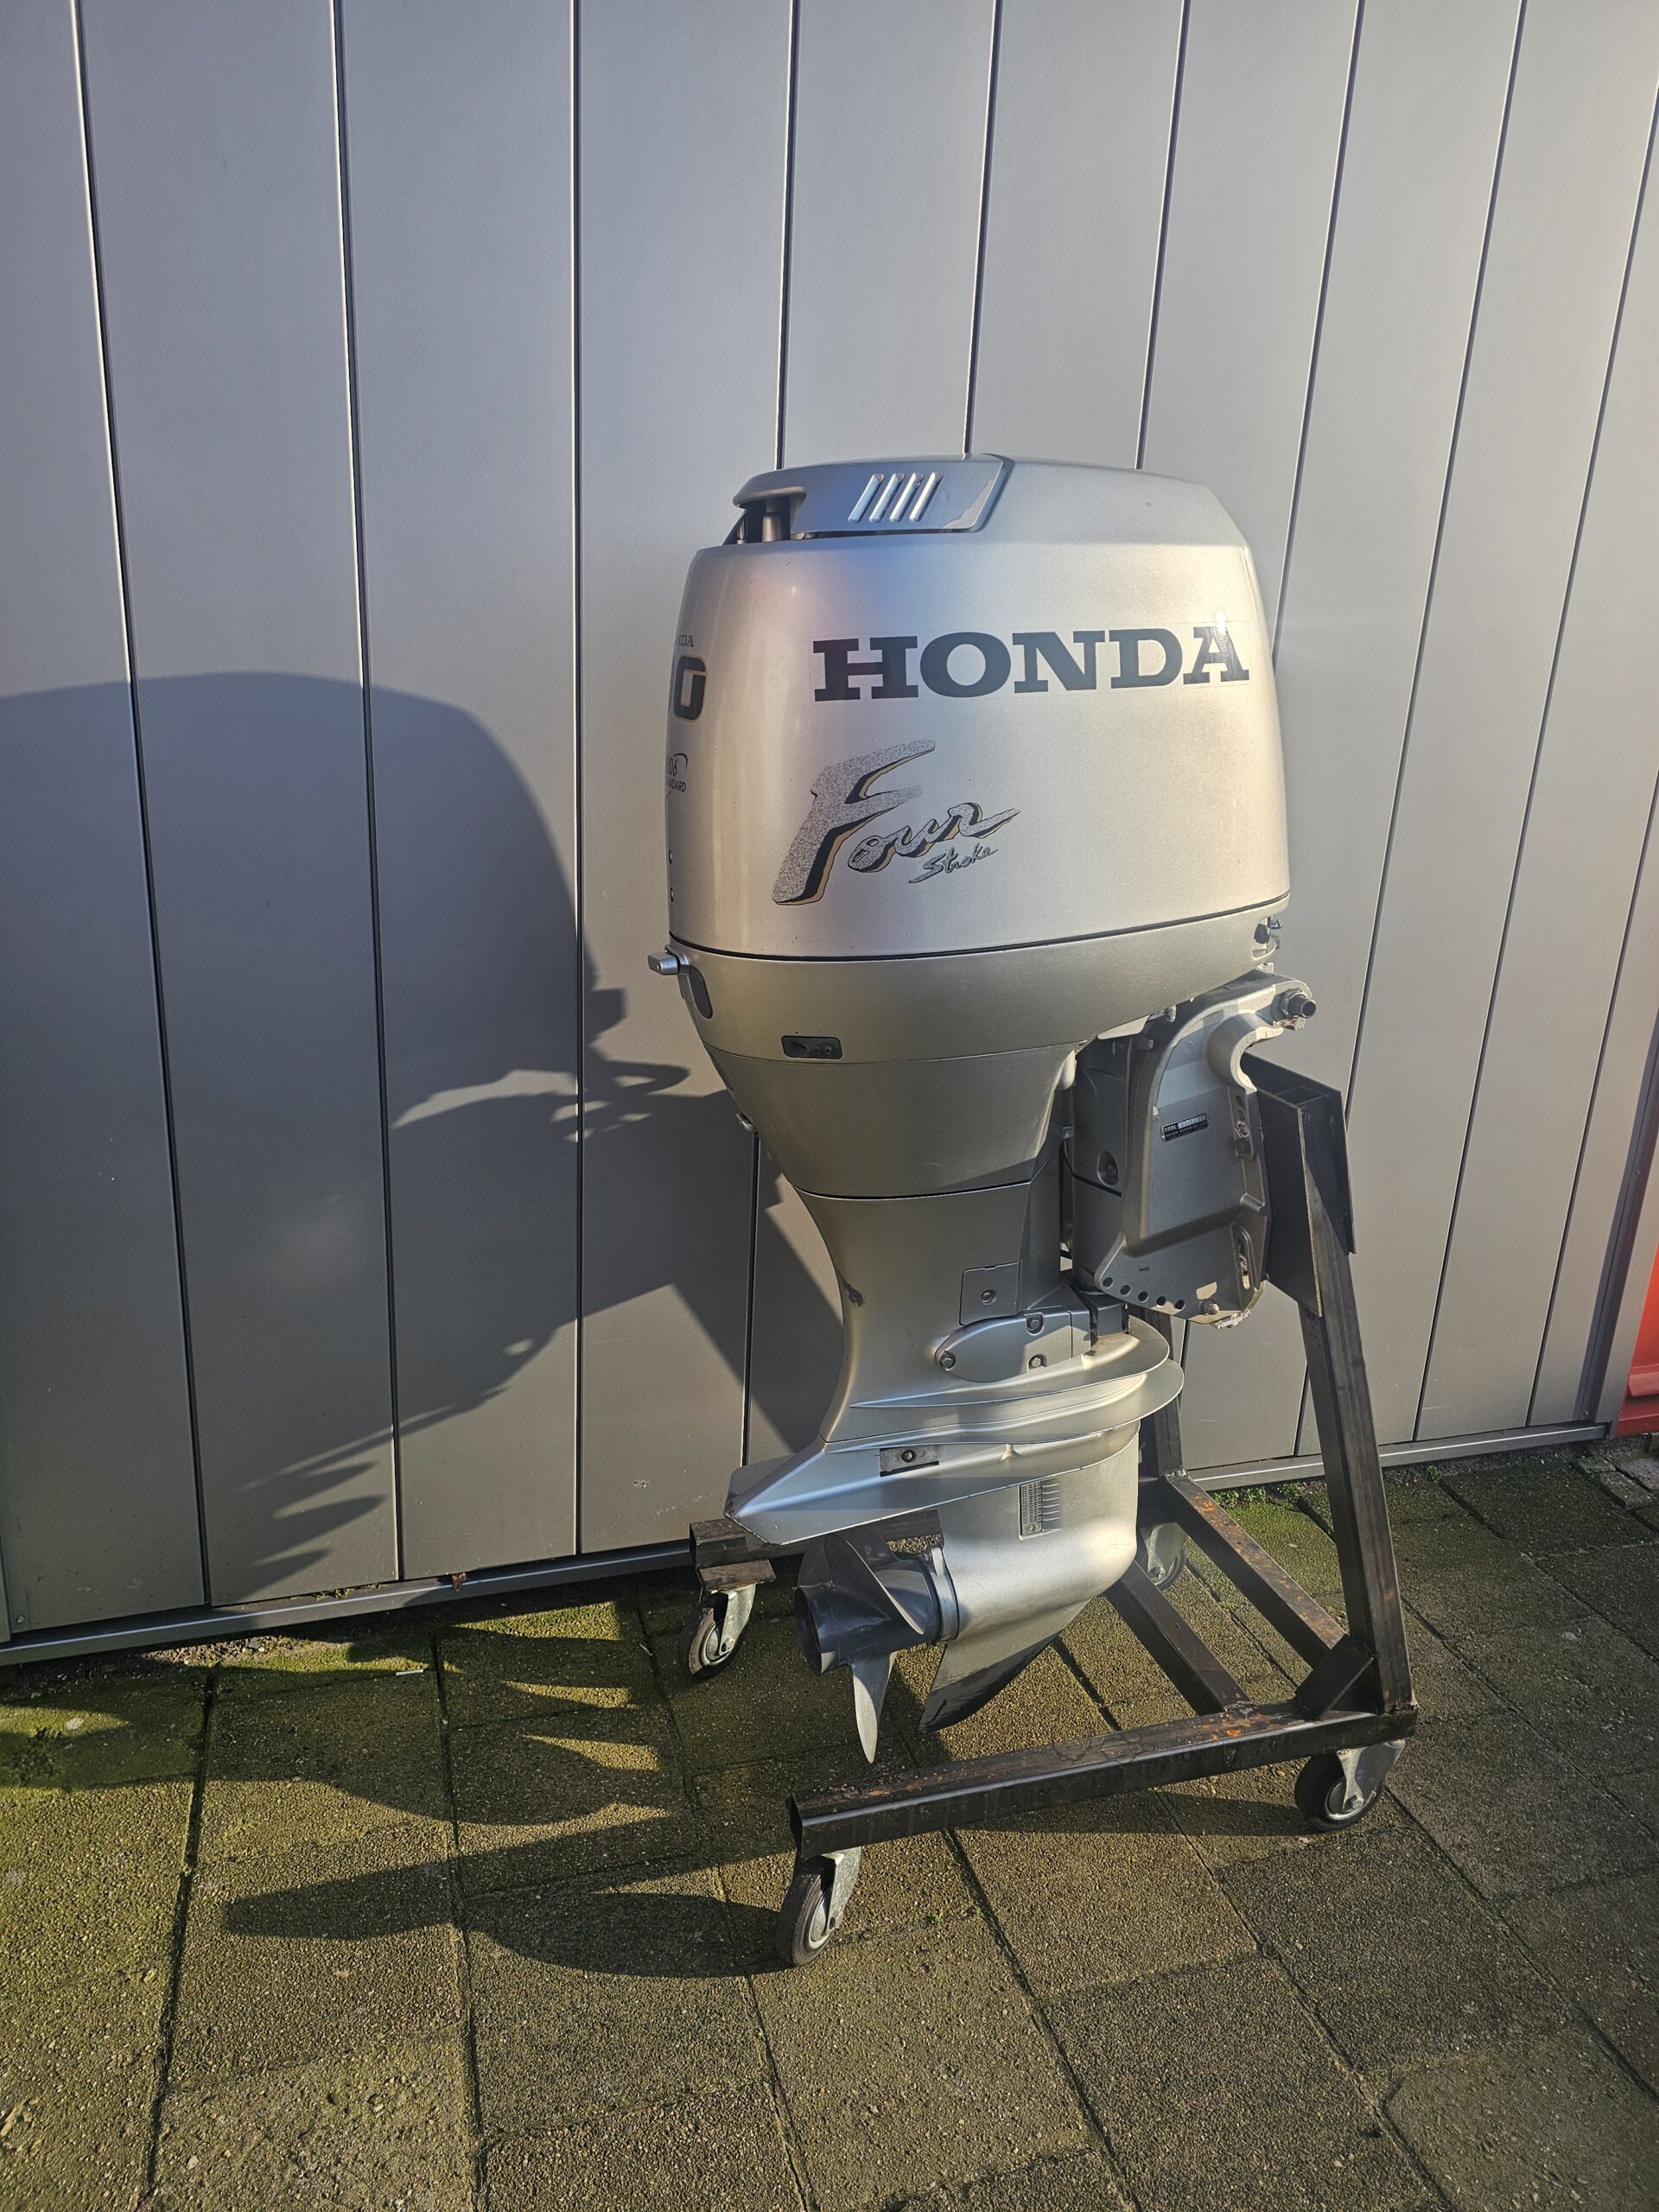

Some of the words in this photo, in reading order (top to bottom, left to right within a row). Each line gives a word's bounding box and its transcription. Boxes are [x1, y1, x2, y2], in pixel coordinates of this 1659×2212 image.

[812, 626, 1249, 702] HONDA
[772, 739, 1021, 906] Four
[908, 843, 998, 883] Stroke
